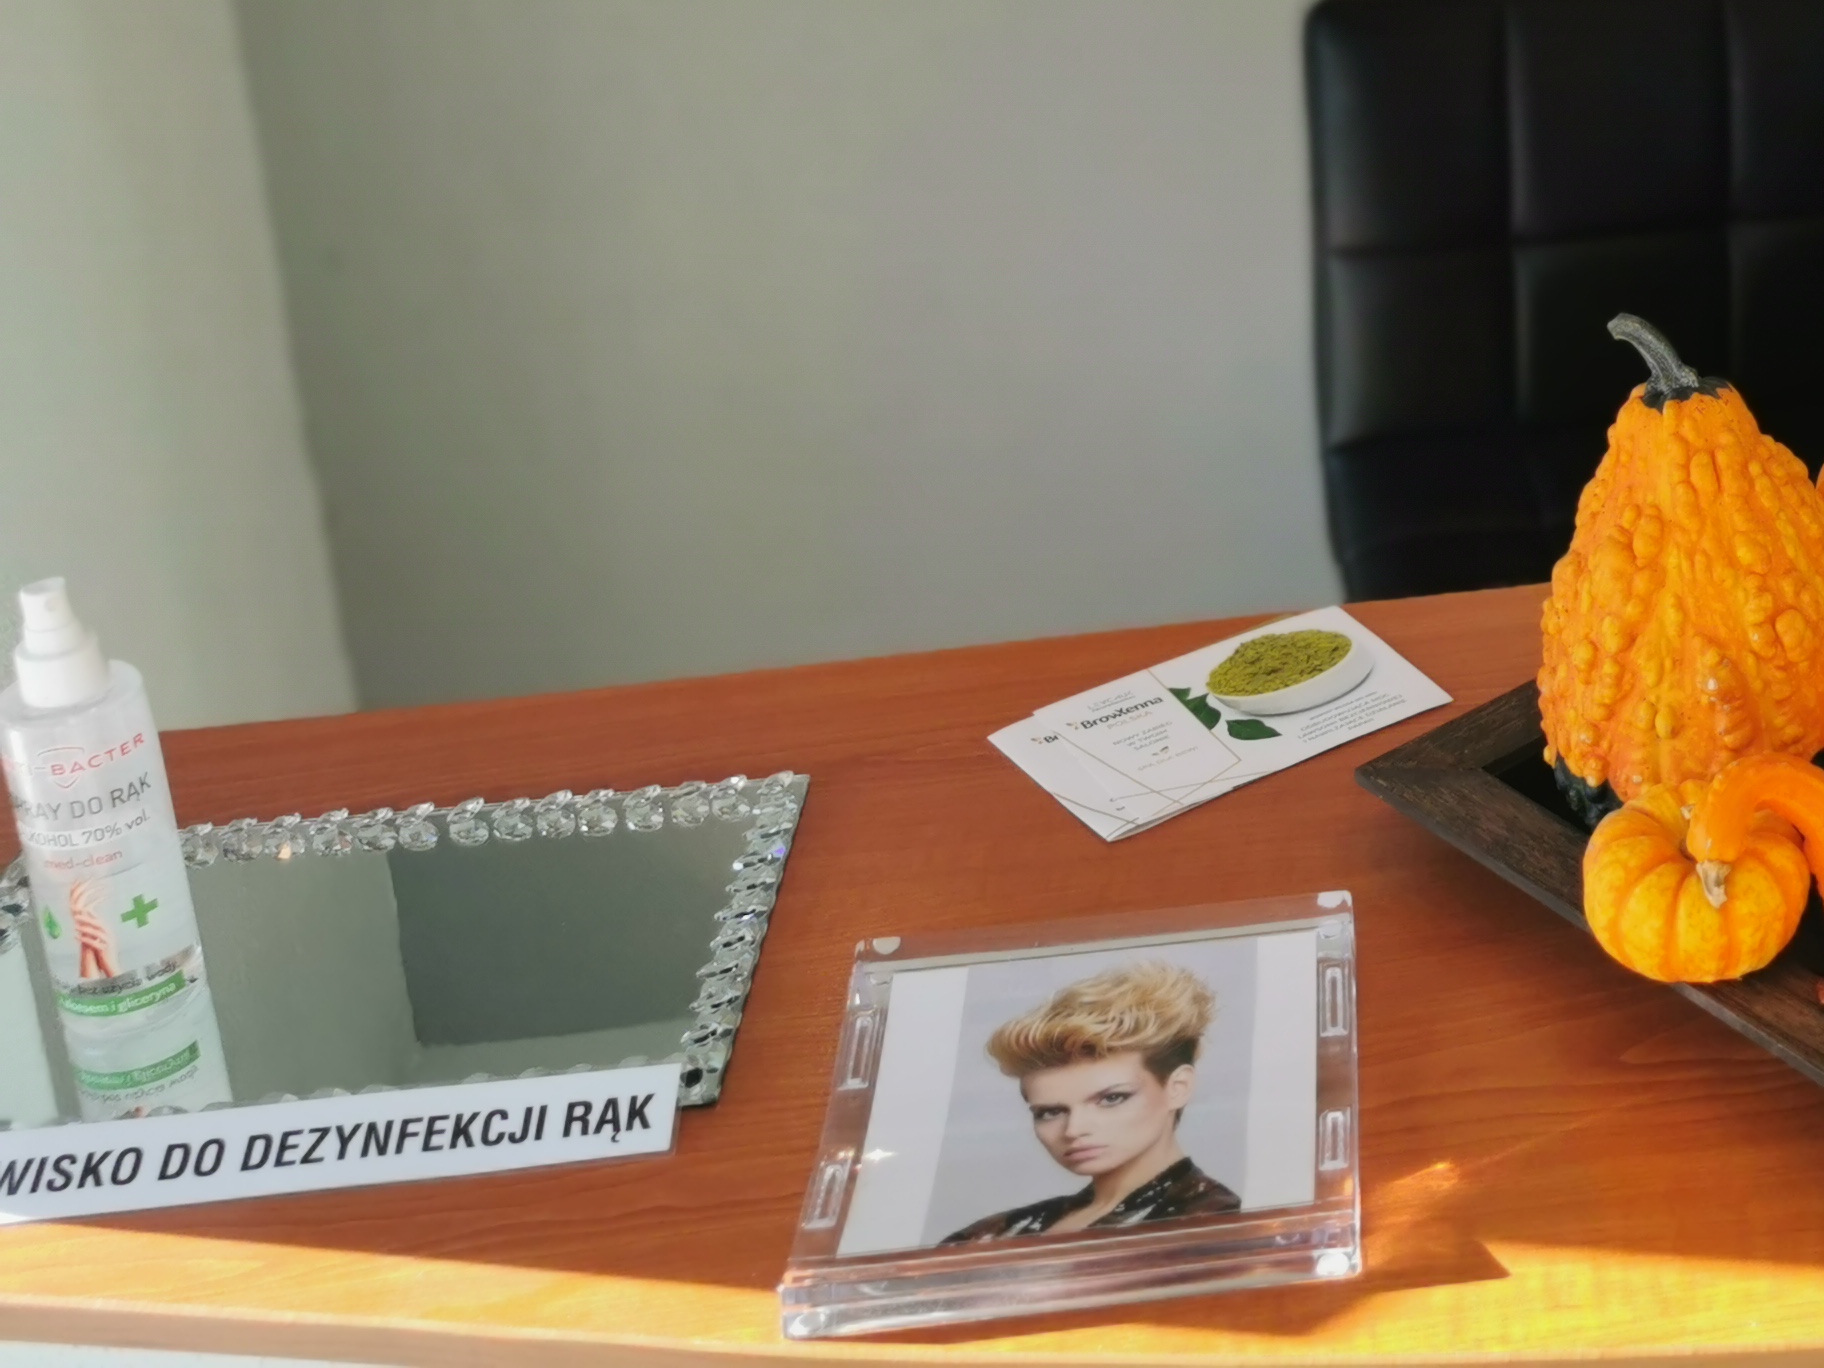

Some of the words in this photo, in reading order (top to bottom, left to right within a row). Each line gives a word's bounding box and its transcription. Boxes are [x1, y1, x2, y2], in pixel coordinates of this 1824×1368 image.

[1080, 696, 1164, 729] BrowXenna
[70, 796, 103, 820] DO
[110, 771, 151, 808] RĄK
[82, 823, 122, 844] 70%
[125, 809, 150, 829] vol.
[157, 1138, 226, 1182] DO
[241, 1104, 548, 1173] DEZYNFEKCJI
[563, 1092, 656, 1144] RĄK
